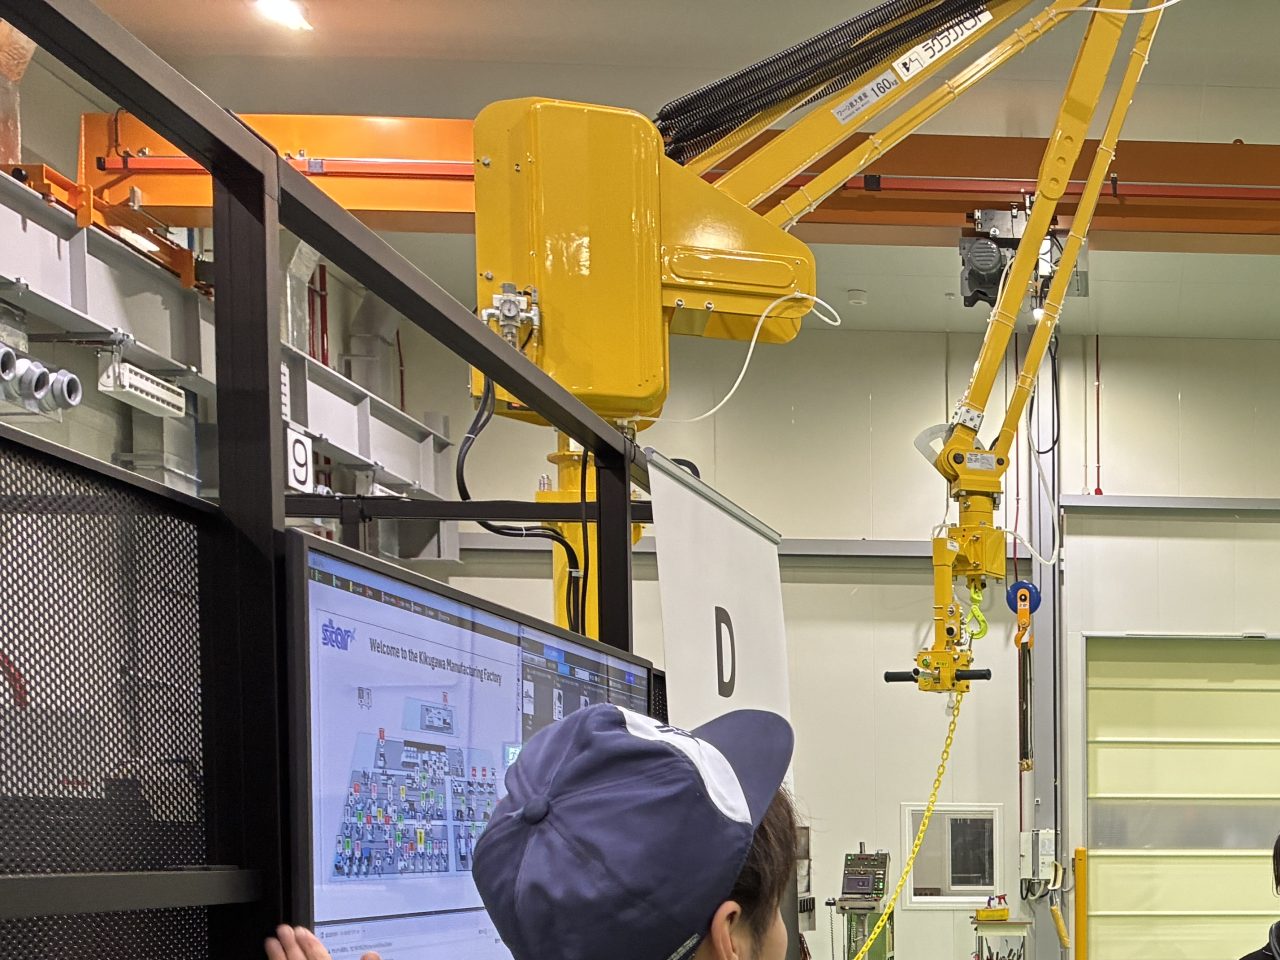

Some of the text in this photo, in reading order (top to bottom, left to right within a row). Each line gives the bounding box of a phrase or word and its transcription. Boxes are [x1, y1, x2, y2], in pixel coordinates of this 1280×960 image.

[293, 438, 308, 485] 9
[322, 618, 352, 651] star
[714, 605, 736, 698] D
[369, 637, 400, 658] Welcome
[401, 646, 407, 660] to
[408, 648, 418, 663] the
[419, 650, 445, 670] Kikugawa
[446, 658, 483, 682] Manufacturing
[484, 668, 501, 686] Factory
